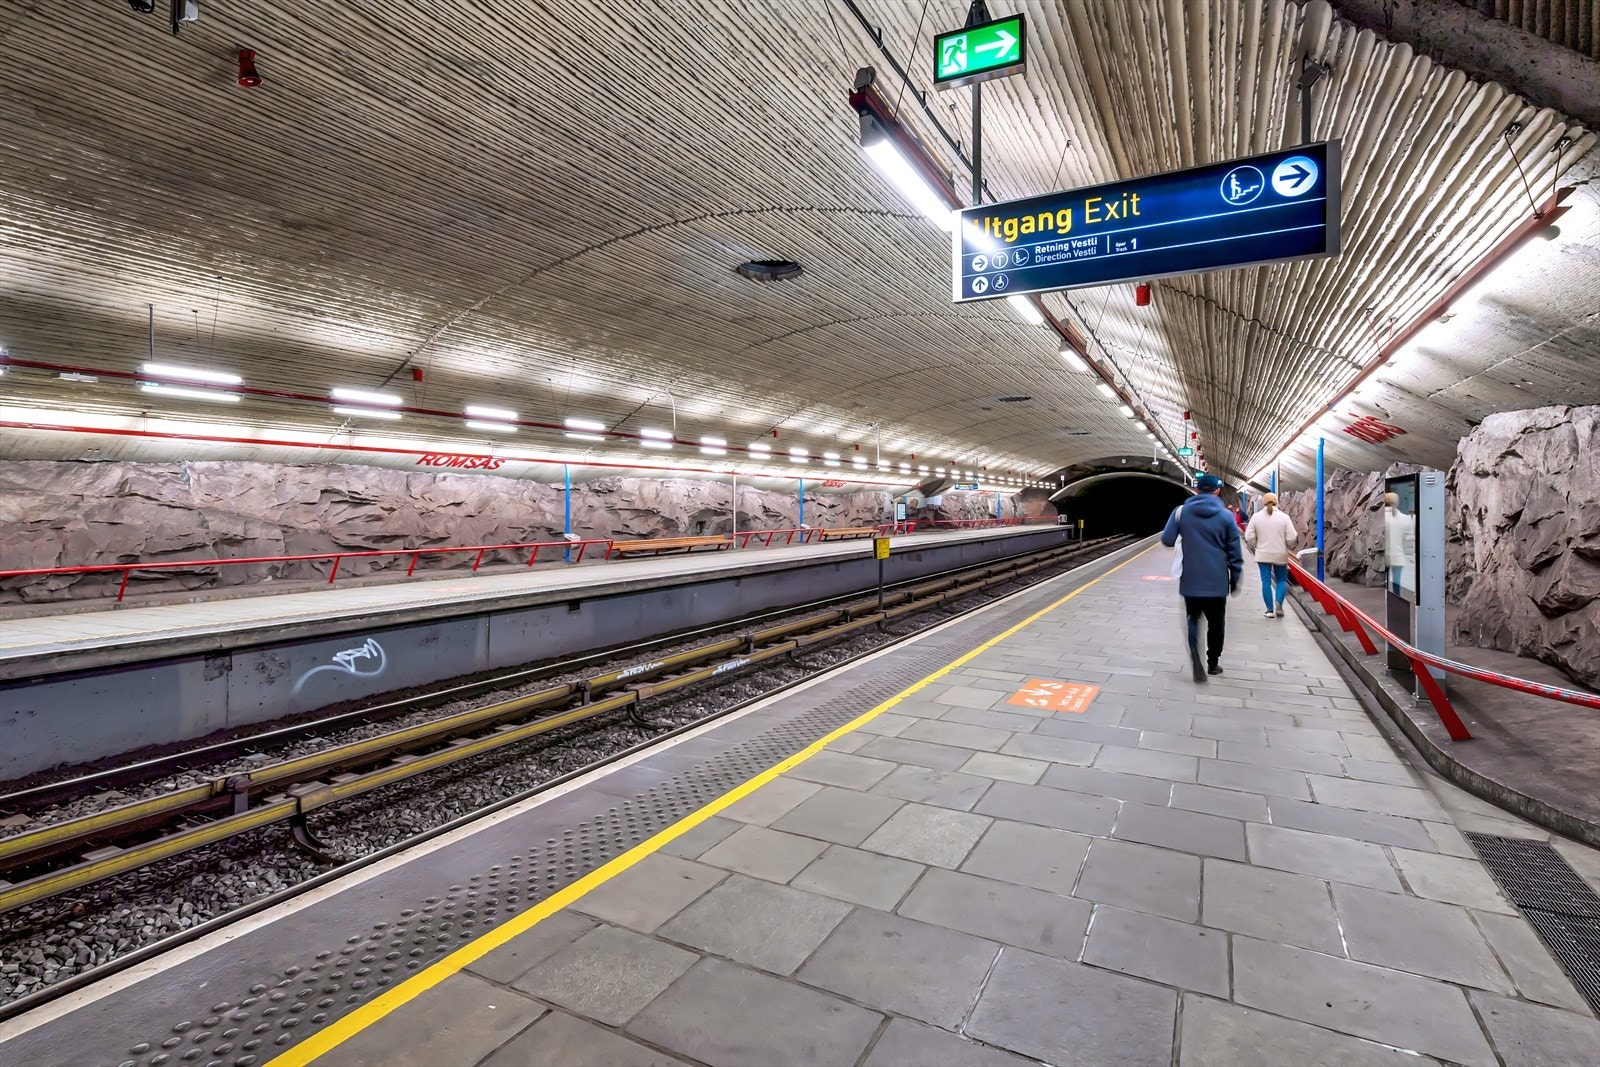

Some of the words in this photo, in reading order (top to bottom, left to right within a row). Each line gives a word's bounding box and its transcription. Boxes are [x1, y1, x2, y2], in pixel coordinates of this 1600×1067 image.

[1085, 193, 1140, 224] Exit
[1035, 242, 1069, 254] Retning
[1071, 237, 1097, 248] Vestli
[1131, 238, 1137, 249] 1
[1035, 252, 1071, 263] Direction
[1073, 247, 1097, 257] Vestli
